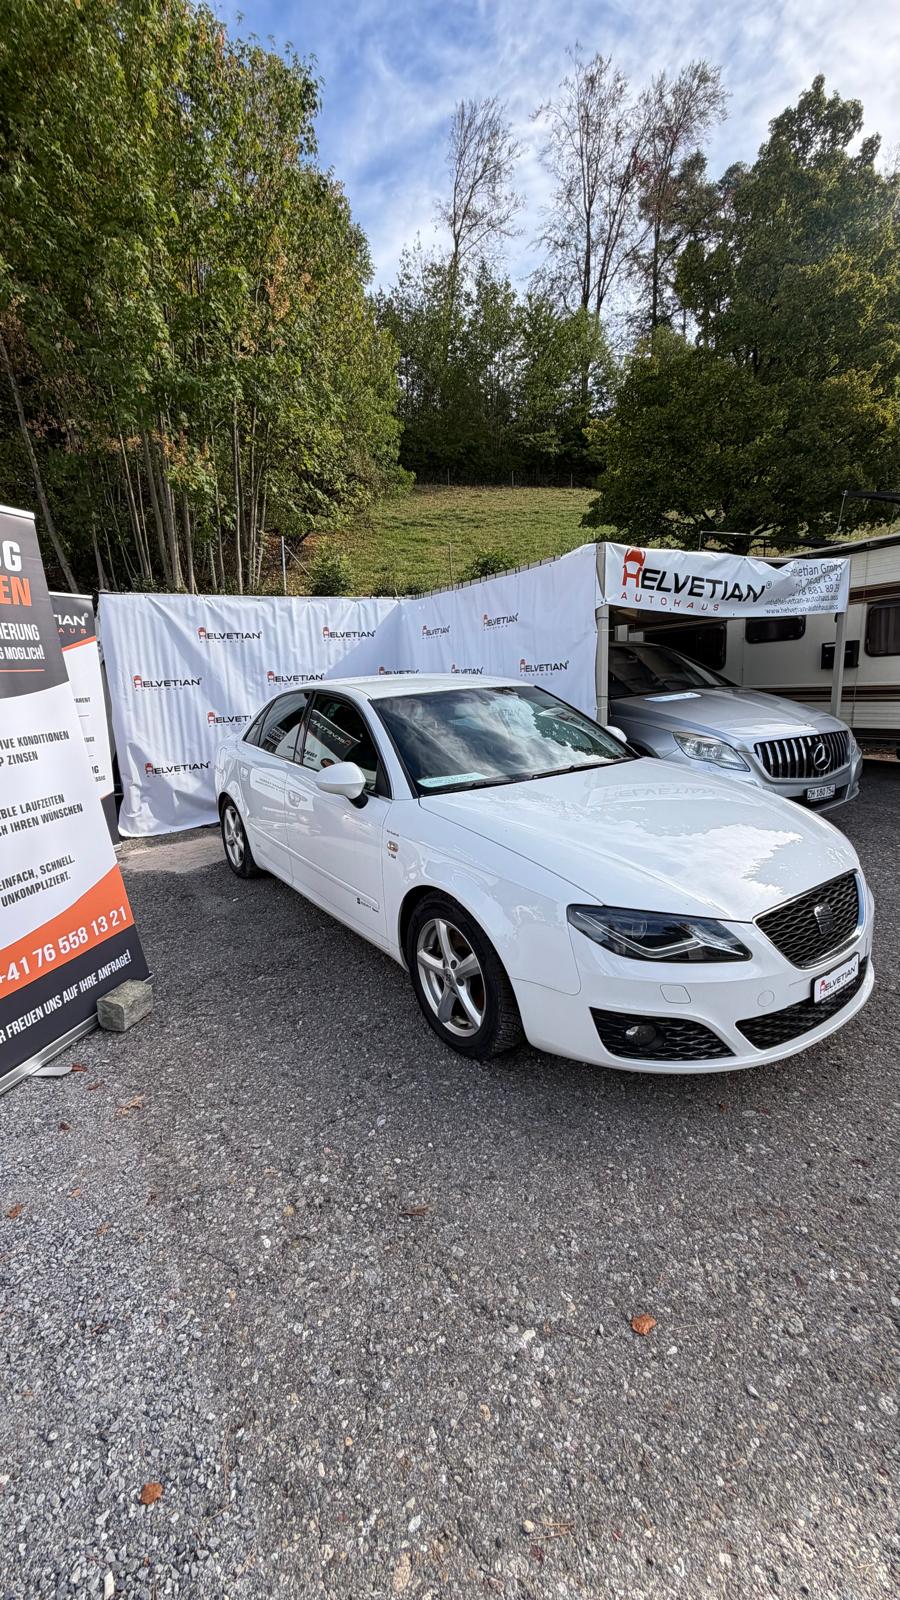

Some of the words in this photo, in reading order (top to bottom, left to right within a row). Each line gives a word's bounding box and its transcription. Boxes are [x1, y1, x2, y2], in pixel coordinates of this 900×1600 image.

[0, 540, 22, 572] G
[0, 575, 33, 606] EN
[620, 591, 720, 611] AUTOHAUS
[17, 730, 70, 747] KONDITIONEN
[6, 750, 39, 766] ZINSEN
[0, 805, 18, 820] BLE
[19, 793, 65, 814] LAUFZEITEN
[10, 816, 39, 833] IHREN
[40, 803, 83, 824] WÜNSCHEN
[0, 871, 71, 907] UNKOMPLIZIERT.
[32, 943, 56, 968] 76
[58, 926, 88, 954] 558
[91, 915, 108, 936] 13
[109, 905, 127, 927] 21
[6, 1005, 44, 1039] FREUEN
[43, 994, 62, 1015] UNS
[63, 984, 79, 1004] AUF
[79, 972, 98, 993] IHRE
[98, 949, 132, 982] ANFRAGE!
